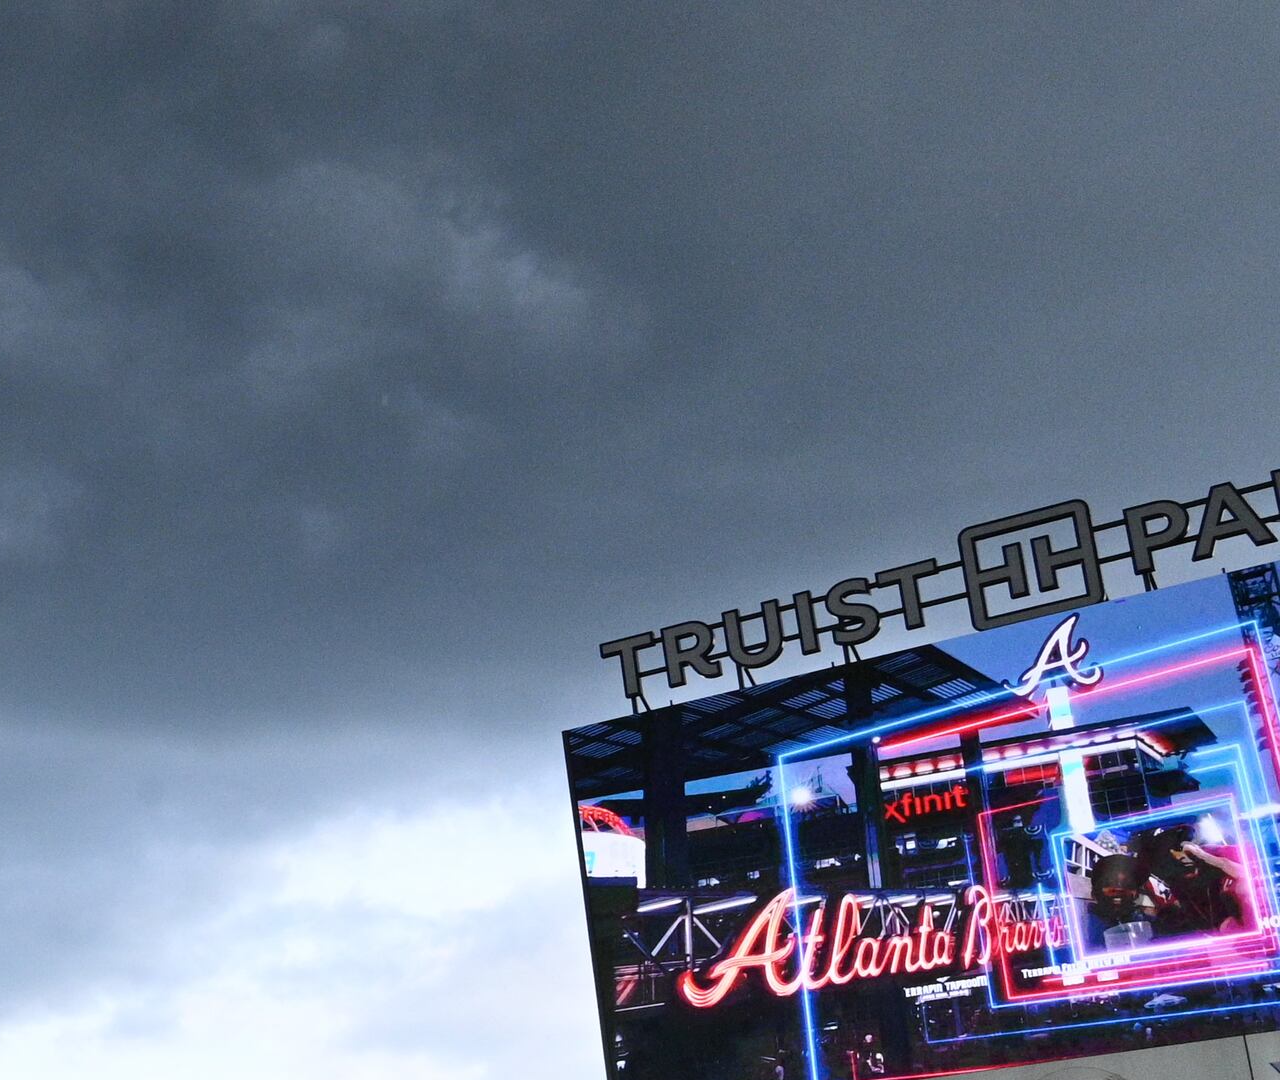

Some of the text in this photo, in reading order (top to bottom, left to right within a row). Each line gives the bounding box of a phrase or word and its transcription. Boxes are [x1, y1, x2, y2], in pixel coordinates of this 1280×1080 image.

[600, 469, 1280, 698] TRUIST PA
[680, 886, 953, 1007] Atlanta
